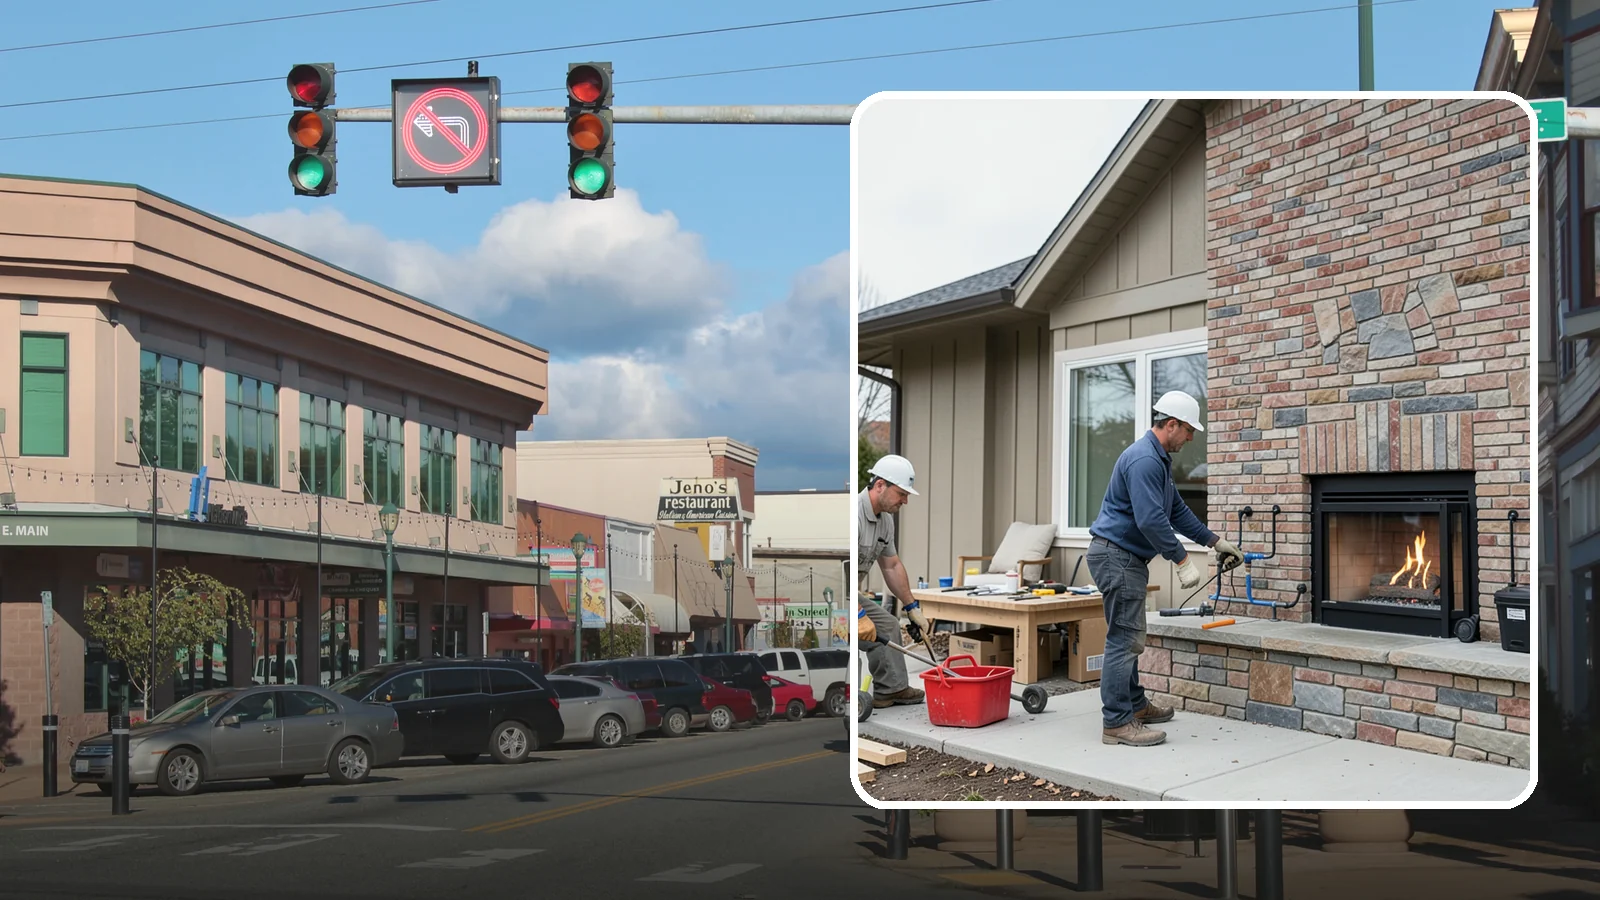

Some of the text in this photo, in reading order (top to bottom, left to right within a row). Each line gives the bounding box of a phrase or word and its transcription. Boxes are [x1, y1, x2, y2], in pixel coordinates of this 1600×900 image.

[669, 480, 727, 494] Jeno's
[665, 496, 731, 509] restaurant
[658, 509, 681, 520] Italian
[685, 509, 715, 519] American
[715, 509, 738, 519] Cuisine
[2, 525, 49, 536] E. MAIN
[797, 607, 829, 616] Street
[790, 619, 824, 627] lass
